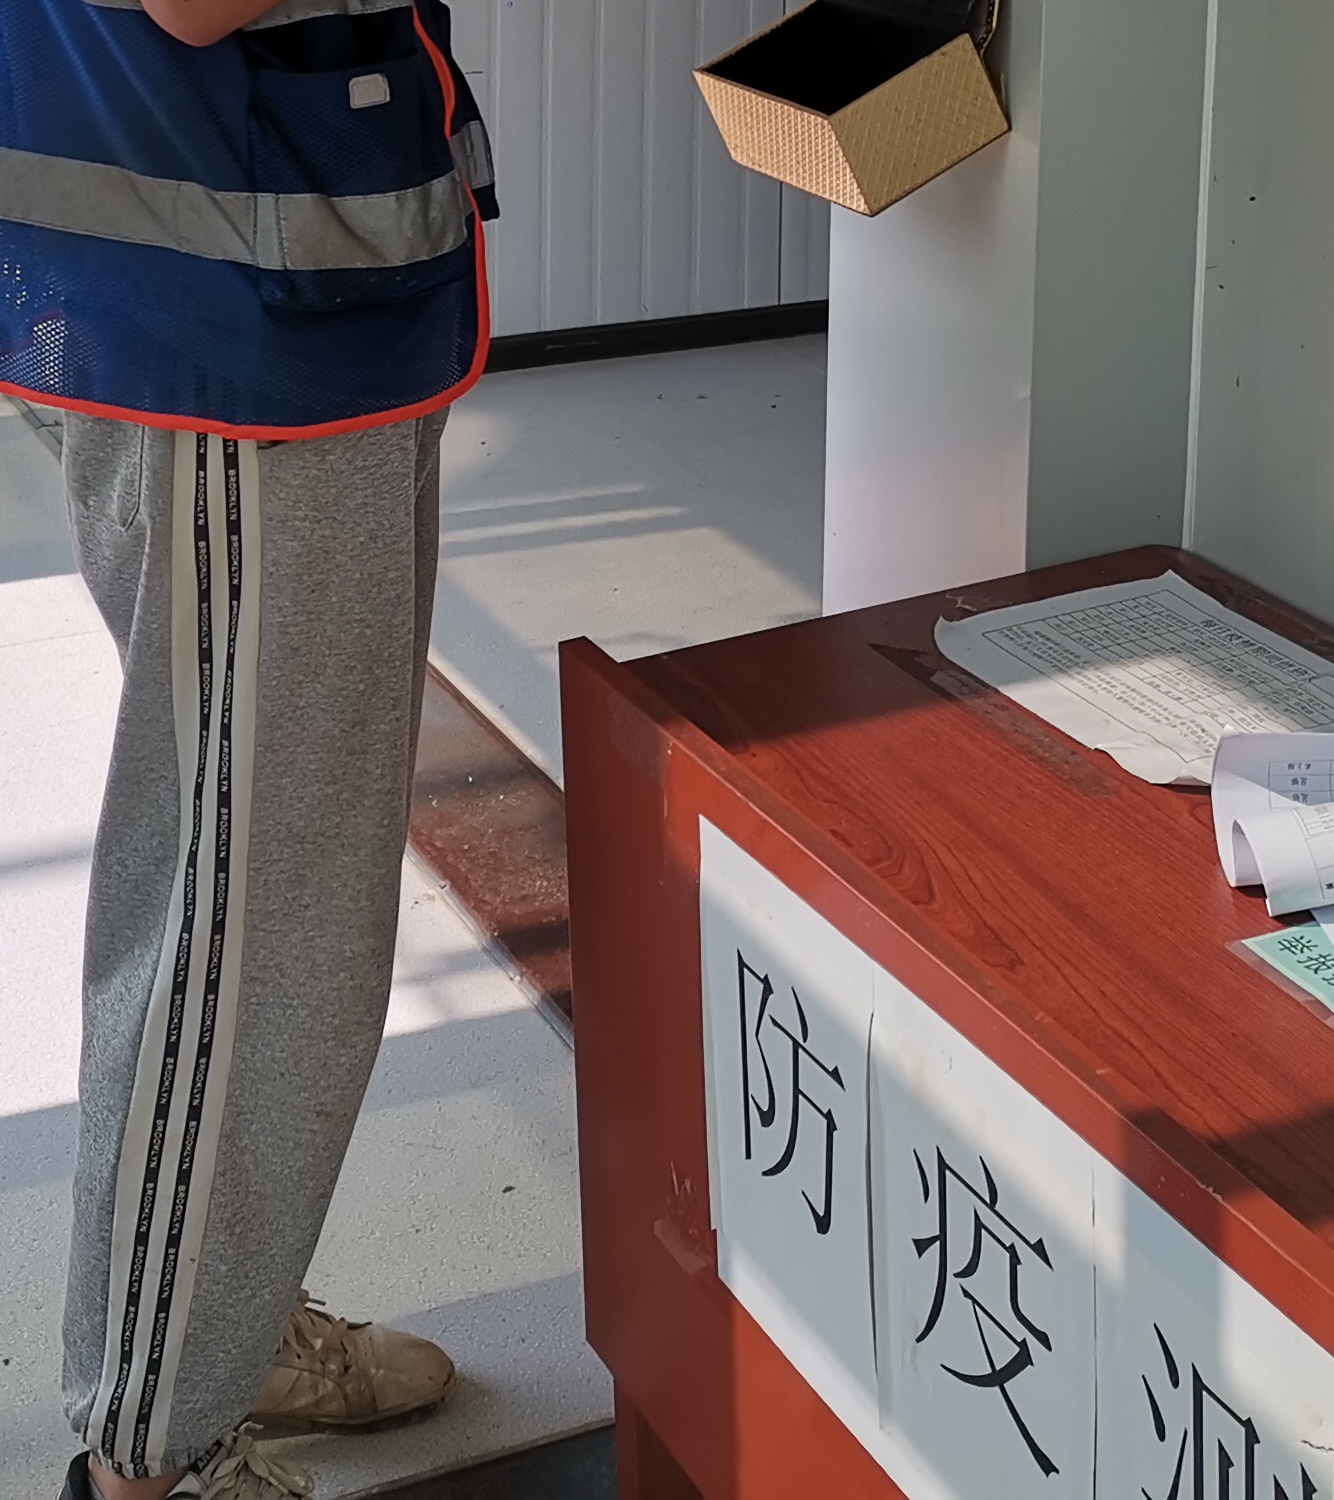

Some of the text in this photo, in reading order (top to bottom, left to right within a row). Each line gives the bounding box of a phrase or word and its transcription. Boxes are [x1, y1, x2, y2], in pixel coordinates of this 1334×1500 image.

[197, 470, 205, 526] BROOKLYN
[227, 469, 238, 521] BROOKLYN
[230, 534, 239, 585] BROOKLYN
[201, 602, 209, 649] BROOKLYN
[202, 663, 211, 714] BROOKLYN
[223, 670, 233, 725] BROOKLYN
[220, 740, 229, 793] BROOKLYN
[219, 807, 229, 858] BROOKLYN
[186, 867, 195, 917] BROOKLYN
[176, 932, 189, 982] BROOKLYN
[209, 934, 222, 980] BROOKLYN
[169, 994, 183, 1043] BROOKLYN
[201, 994, 215, 1044] BROOKLYN
[159, 1057, 174, 1105] BROOKLYN
[192, 1057, 207, 1106] BROOKLYN
[149, 1119, 164, 1168] BROOKLYN
[181, 1120, 198, 1170] BROOKLYN
[139, 1183, 154, 1233] BROOKLYN
[171, 1185, 186, 1234] BROOKLYN
[130, 1245, 145, 1294] BROOKLYN
[161, 1248, 176, 1298] BROOKLYN
[123, 1306, 135, 1351] BROOKLYN
[152, 1312, 166, 1360] BROOKLYN
[110, 1363, 129, 1412] BROOKLYN
